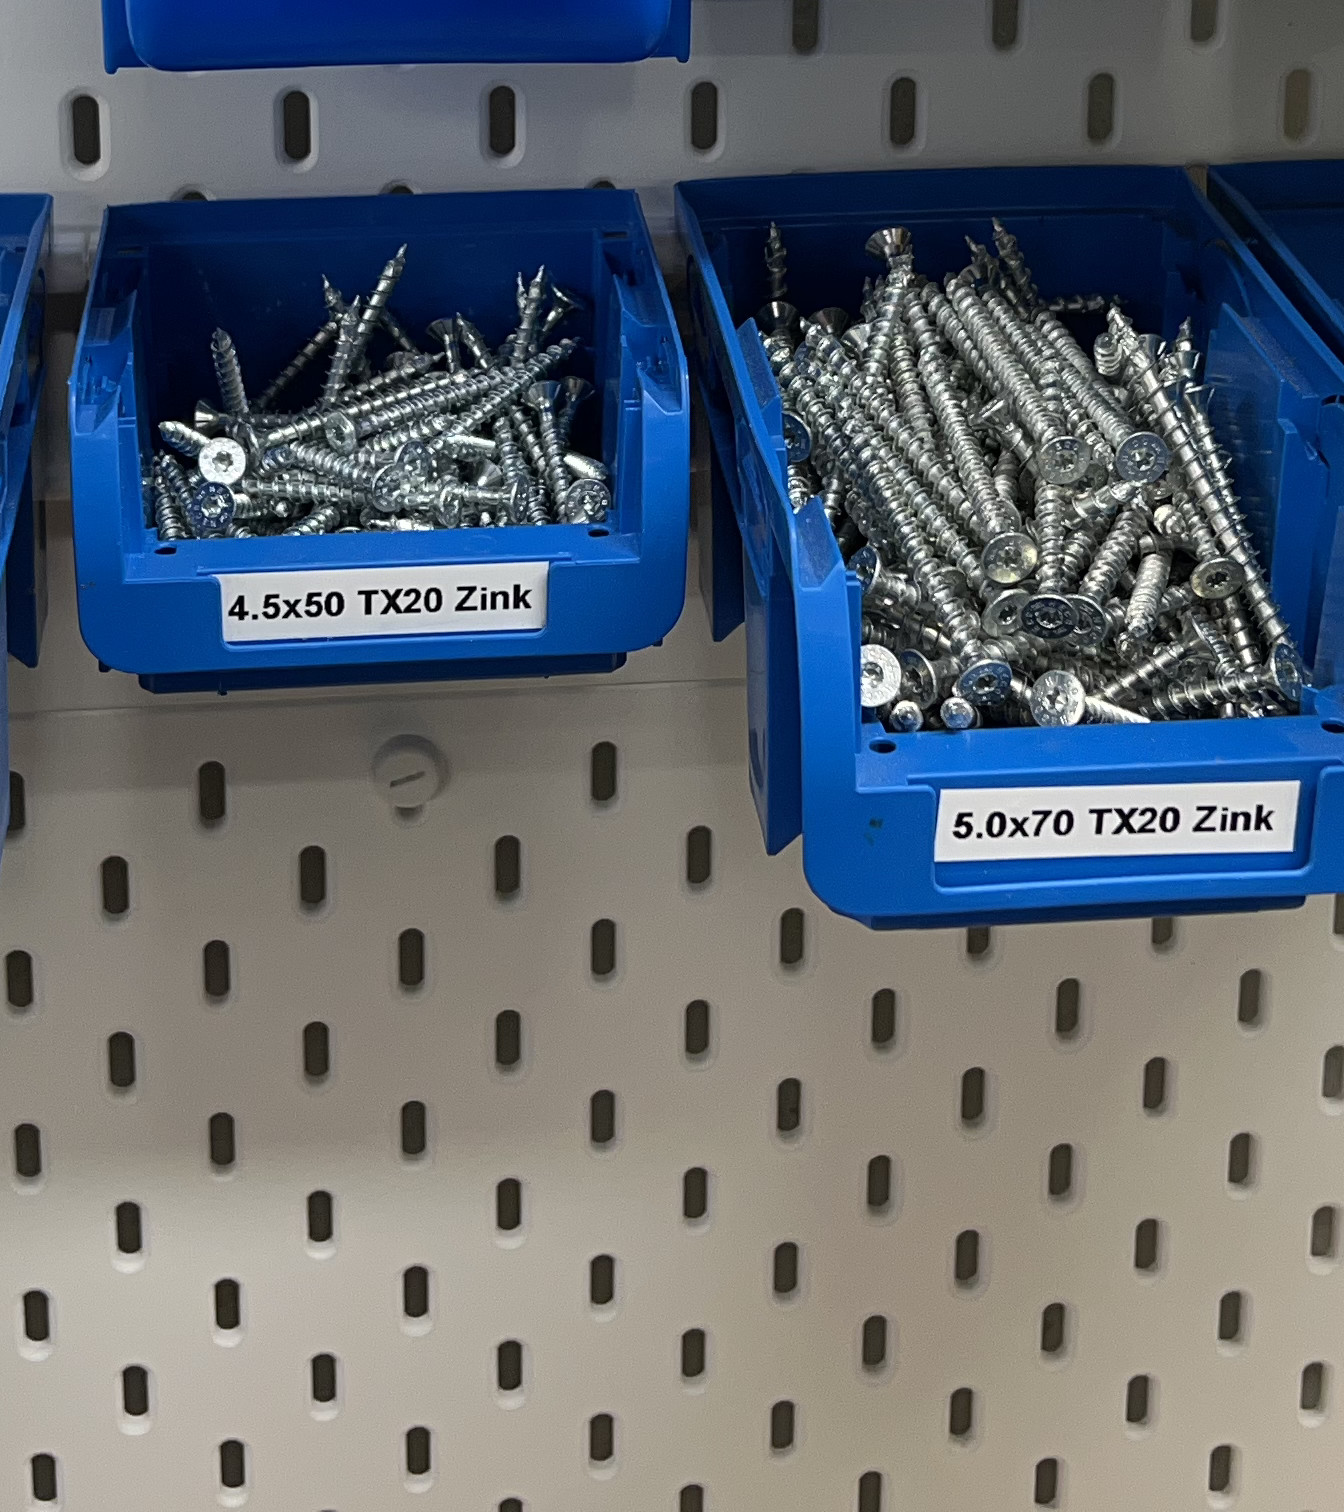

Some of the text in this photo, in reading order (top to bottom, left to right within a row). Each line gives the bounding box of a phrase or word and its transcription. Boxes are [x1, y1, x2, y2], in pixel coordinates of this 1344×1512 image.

[227, 583, 533, 621] 4.5x50 TX20 Zink
[952, 804, 1274, 839] 5.0x70 TX20 Zink
